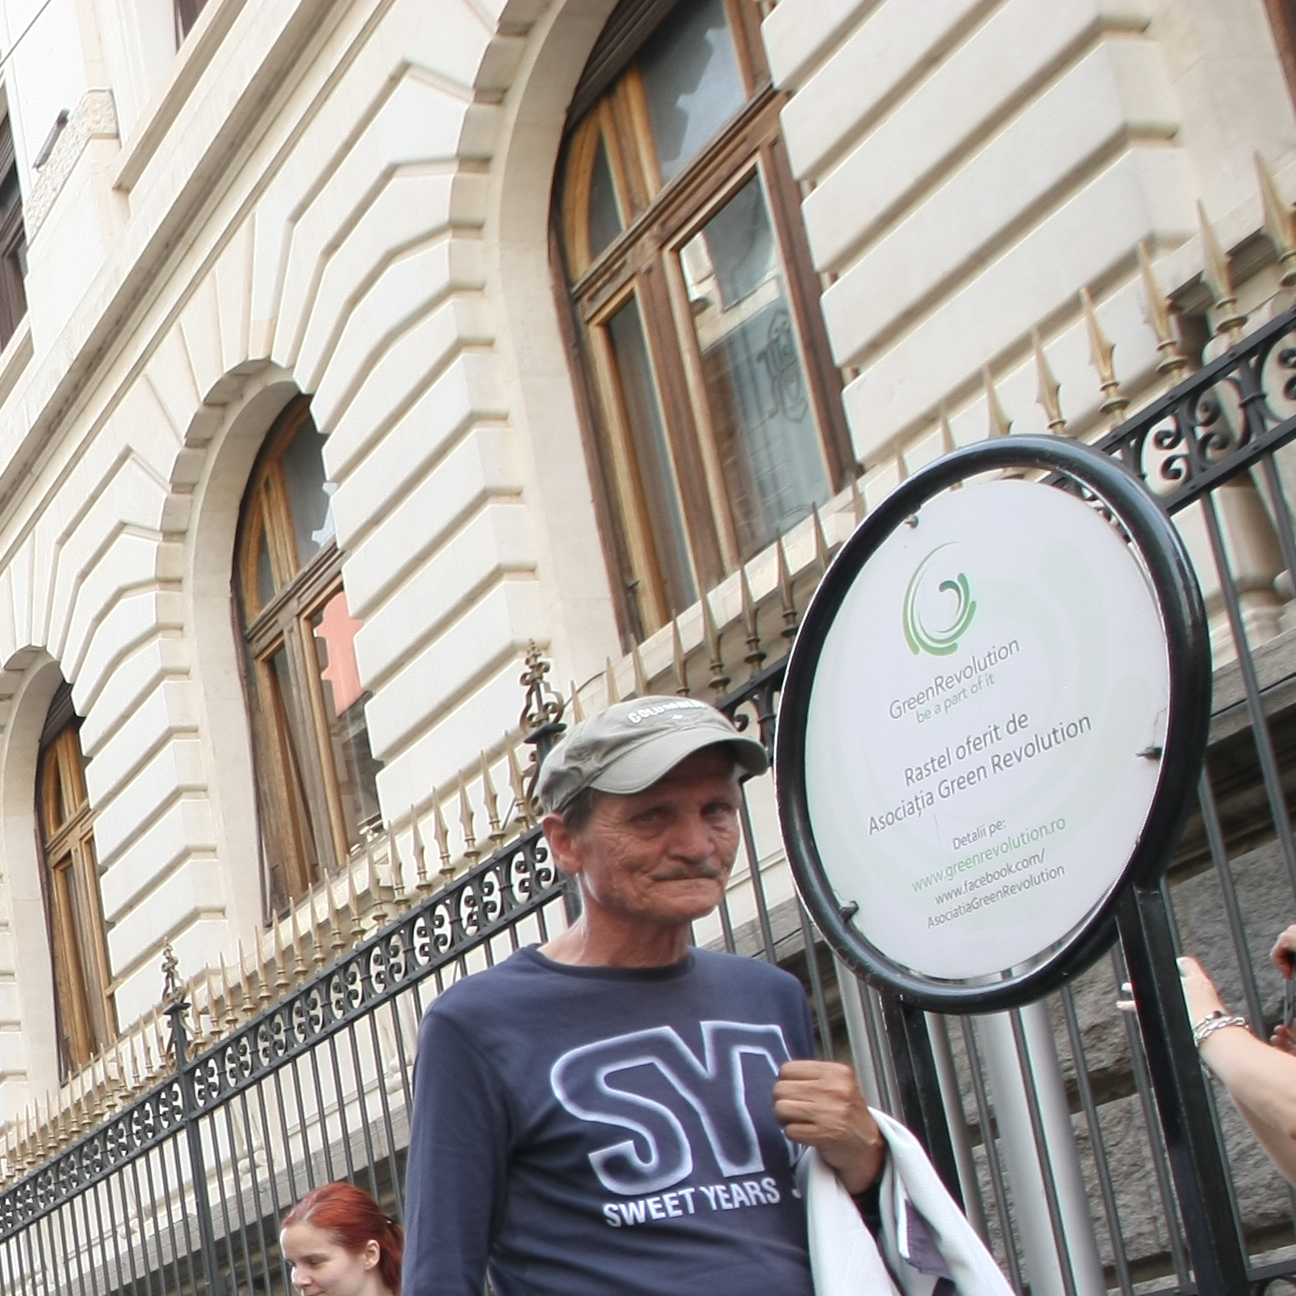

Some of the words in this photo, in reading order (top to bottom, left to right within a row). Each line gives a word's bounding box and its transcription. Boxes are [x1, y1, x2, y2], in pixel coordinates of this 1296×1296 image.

[889, 640, 1020, 719] GreenRevolution
[916, 711, 932, 724] be
[934, 704, 942, 715] a
[943, 688, 968, 713] part
[970, 675, 983, 695] of
[985, 673, 996, 686] it
[904, 747, 952, 787] Rastel
[955, 725, 1002, 761] oferit
[1005, 712, 1029, 736] de
[937, 764, 988, 799] Green
[990, 716, 1092, 775] Revolution
[912, 818, 1066, 892] www.greenrevolution.ro
[953, 825, 987, 850] Detalii
[989, 819, 1007, 837] pe:
[927, 865, 1065, 929] AsociatiaGreenRevolution
[935, 847, 1046, 905] www.facebook.com/
[603, 1187, 696, 1228] SWEET
[699, 1177, 781, 1211] YEARS
